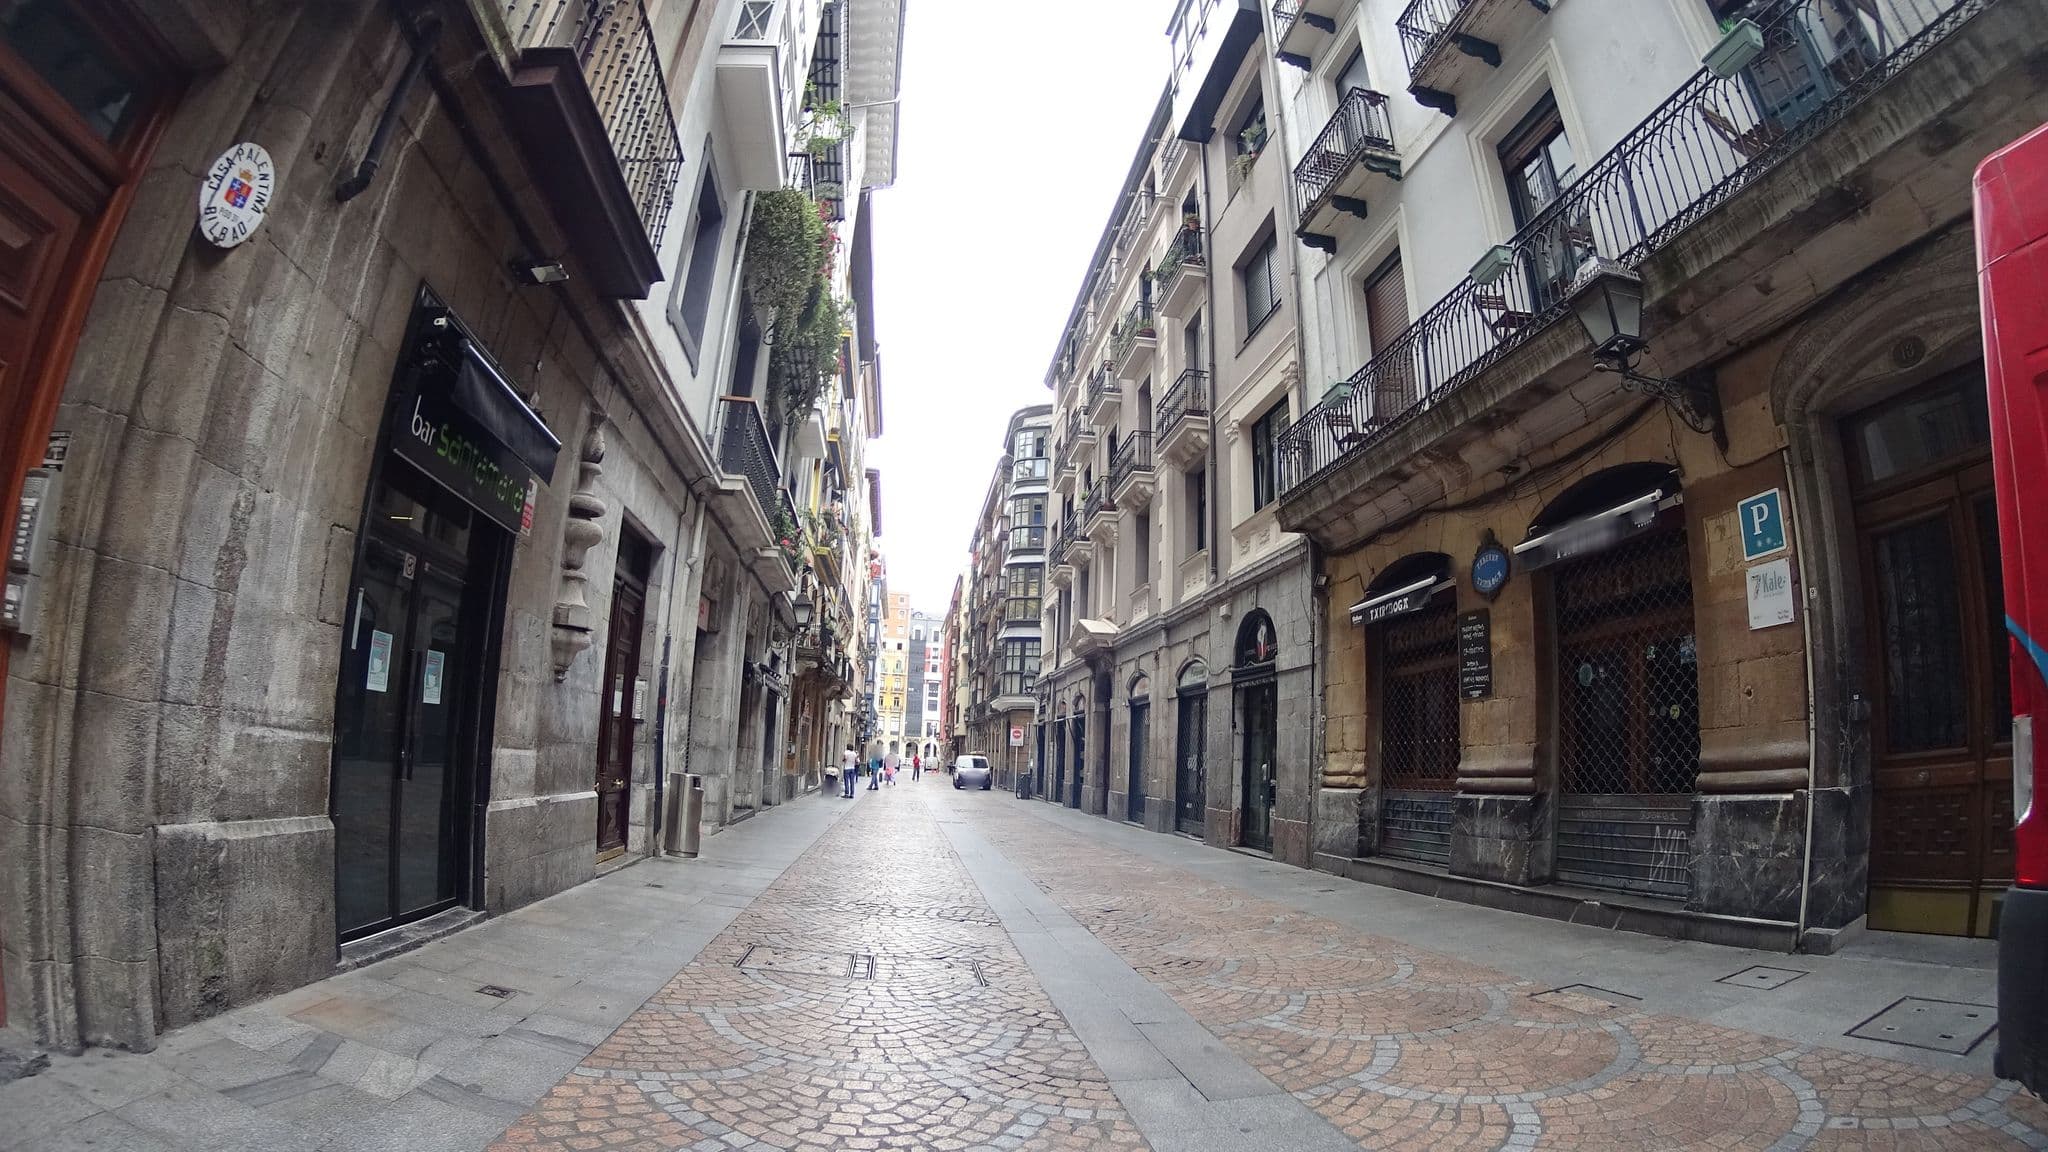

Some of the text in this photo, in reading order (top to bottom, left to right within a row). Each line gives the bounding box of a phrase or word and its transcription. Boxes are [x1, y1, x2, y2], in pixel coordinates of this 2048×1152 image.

[208, 156, 236, 190] CASA
[204, 206, 247, 242] BILBAO
[411, 394, 437, 446] bar
